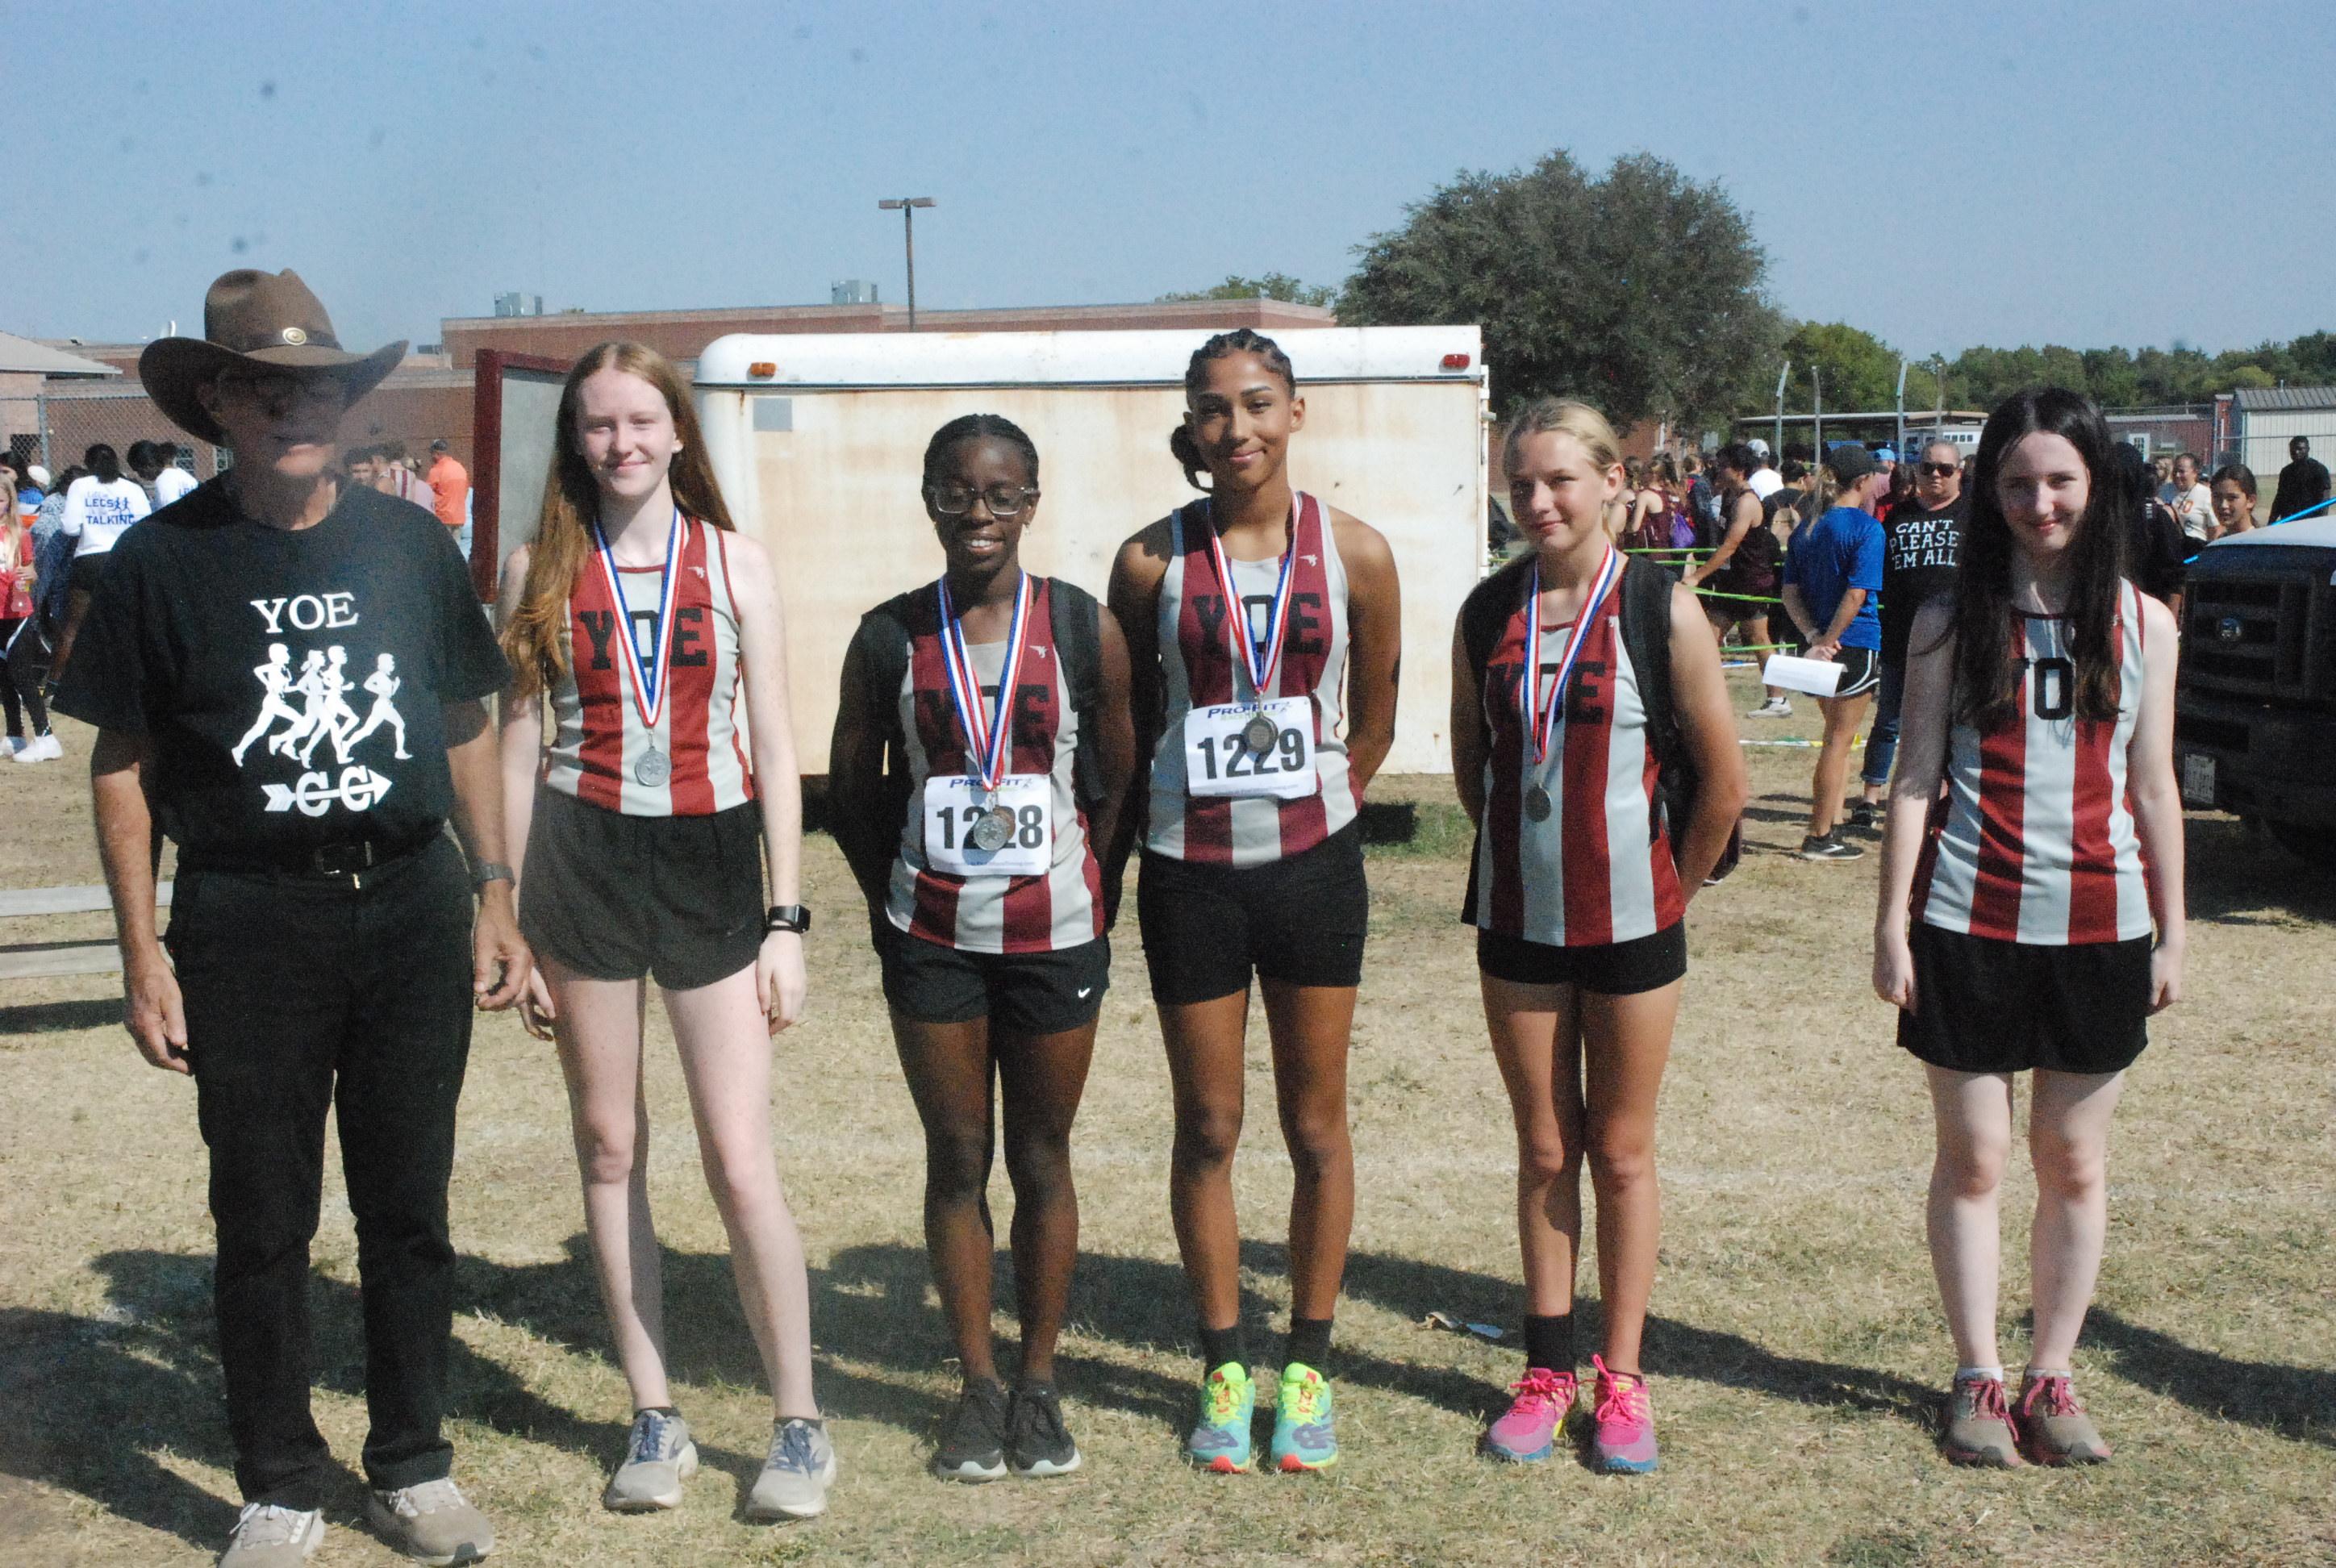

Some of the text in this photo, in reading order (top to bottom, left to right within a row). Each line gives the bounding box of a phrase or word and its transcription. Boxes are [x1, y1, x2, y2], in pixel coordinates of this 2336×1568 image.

[1896, 519, 1954, 534] CAN'T
[1889, 531, 1960, 555] PLEASE
[1923, 548, 1958, 568] ALL
[250, 591, 359, 634] YOE
